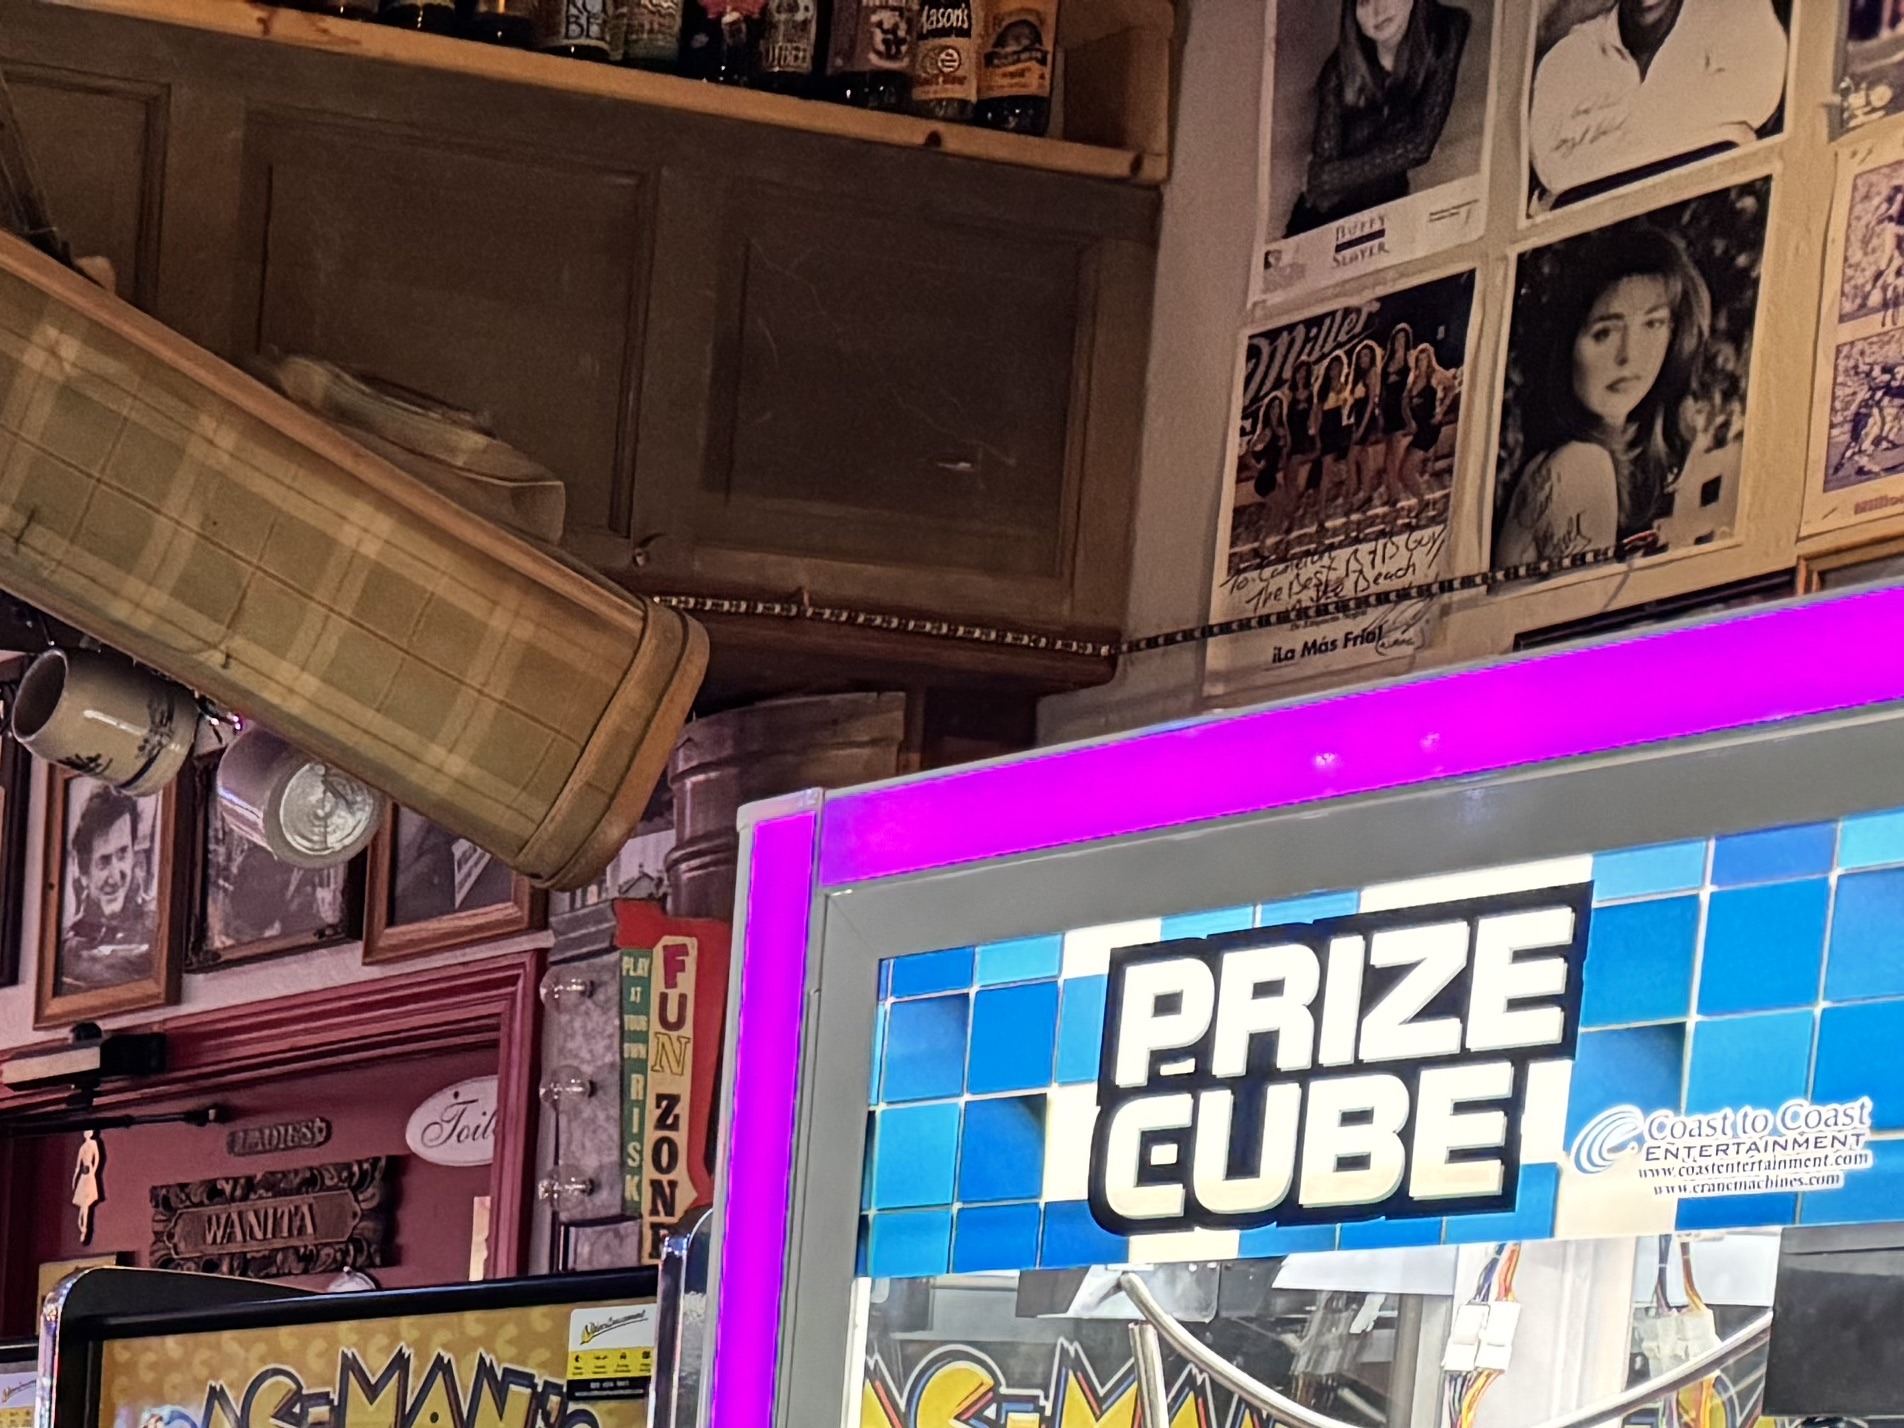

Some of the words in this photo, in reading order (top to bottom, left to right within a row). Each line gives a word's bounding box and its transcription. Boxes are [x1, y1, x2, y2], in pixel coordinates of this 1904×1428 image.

[622, 957, 650, 978] PLAY
[629, 986, 642, 1003] AT
[652, 942, 692, 1077] FUN
[1116, 904, 1578, 1088] PRIZE
[624, 1072, 646, 1201] RISK
[1104, 1062, 1515, 1220] CUBE
[1648, 1109, 1730, 1142] Coast
[1742, 1106, 1769, 1136] to
[1780, 1100, 1867, 1131] Coast
[1638, 1152, 1870, 1179] www.coastentertainment.com
[1645, 1133, 1867, 1162] ENTERTAINMENT
[204, 1203, 315, 1246] WANITA
